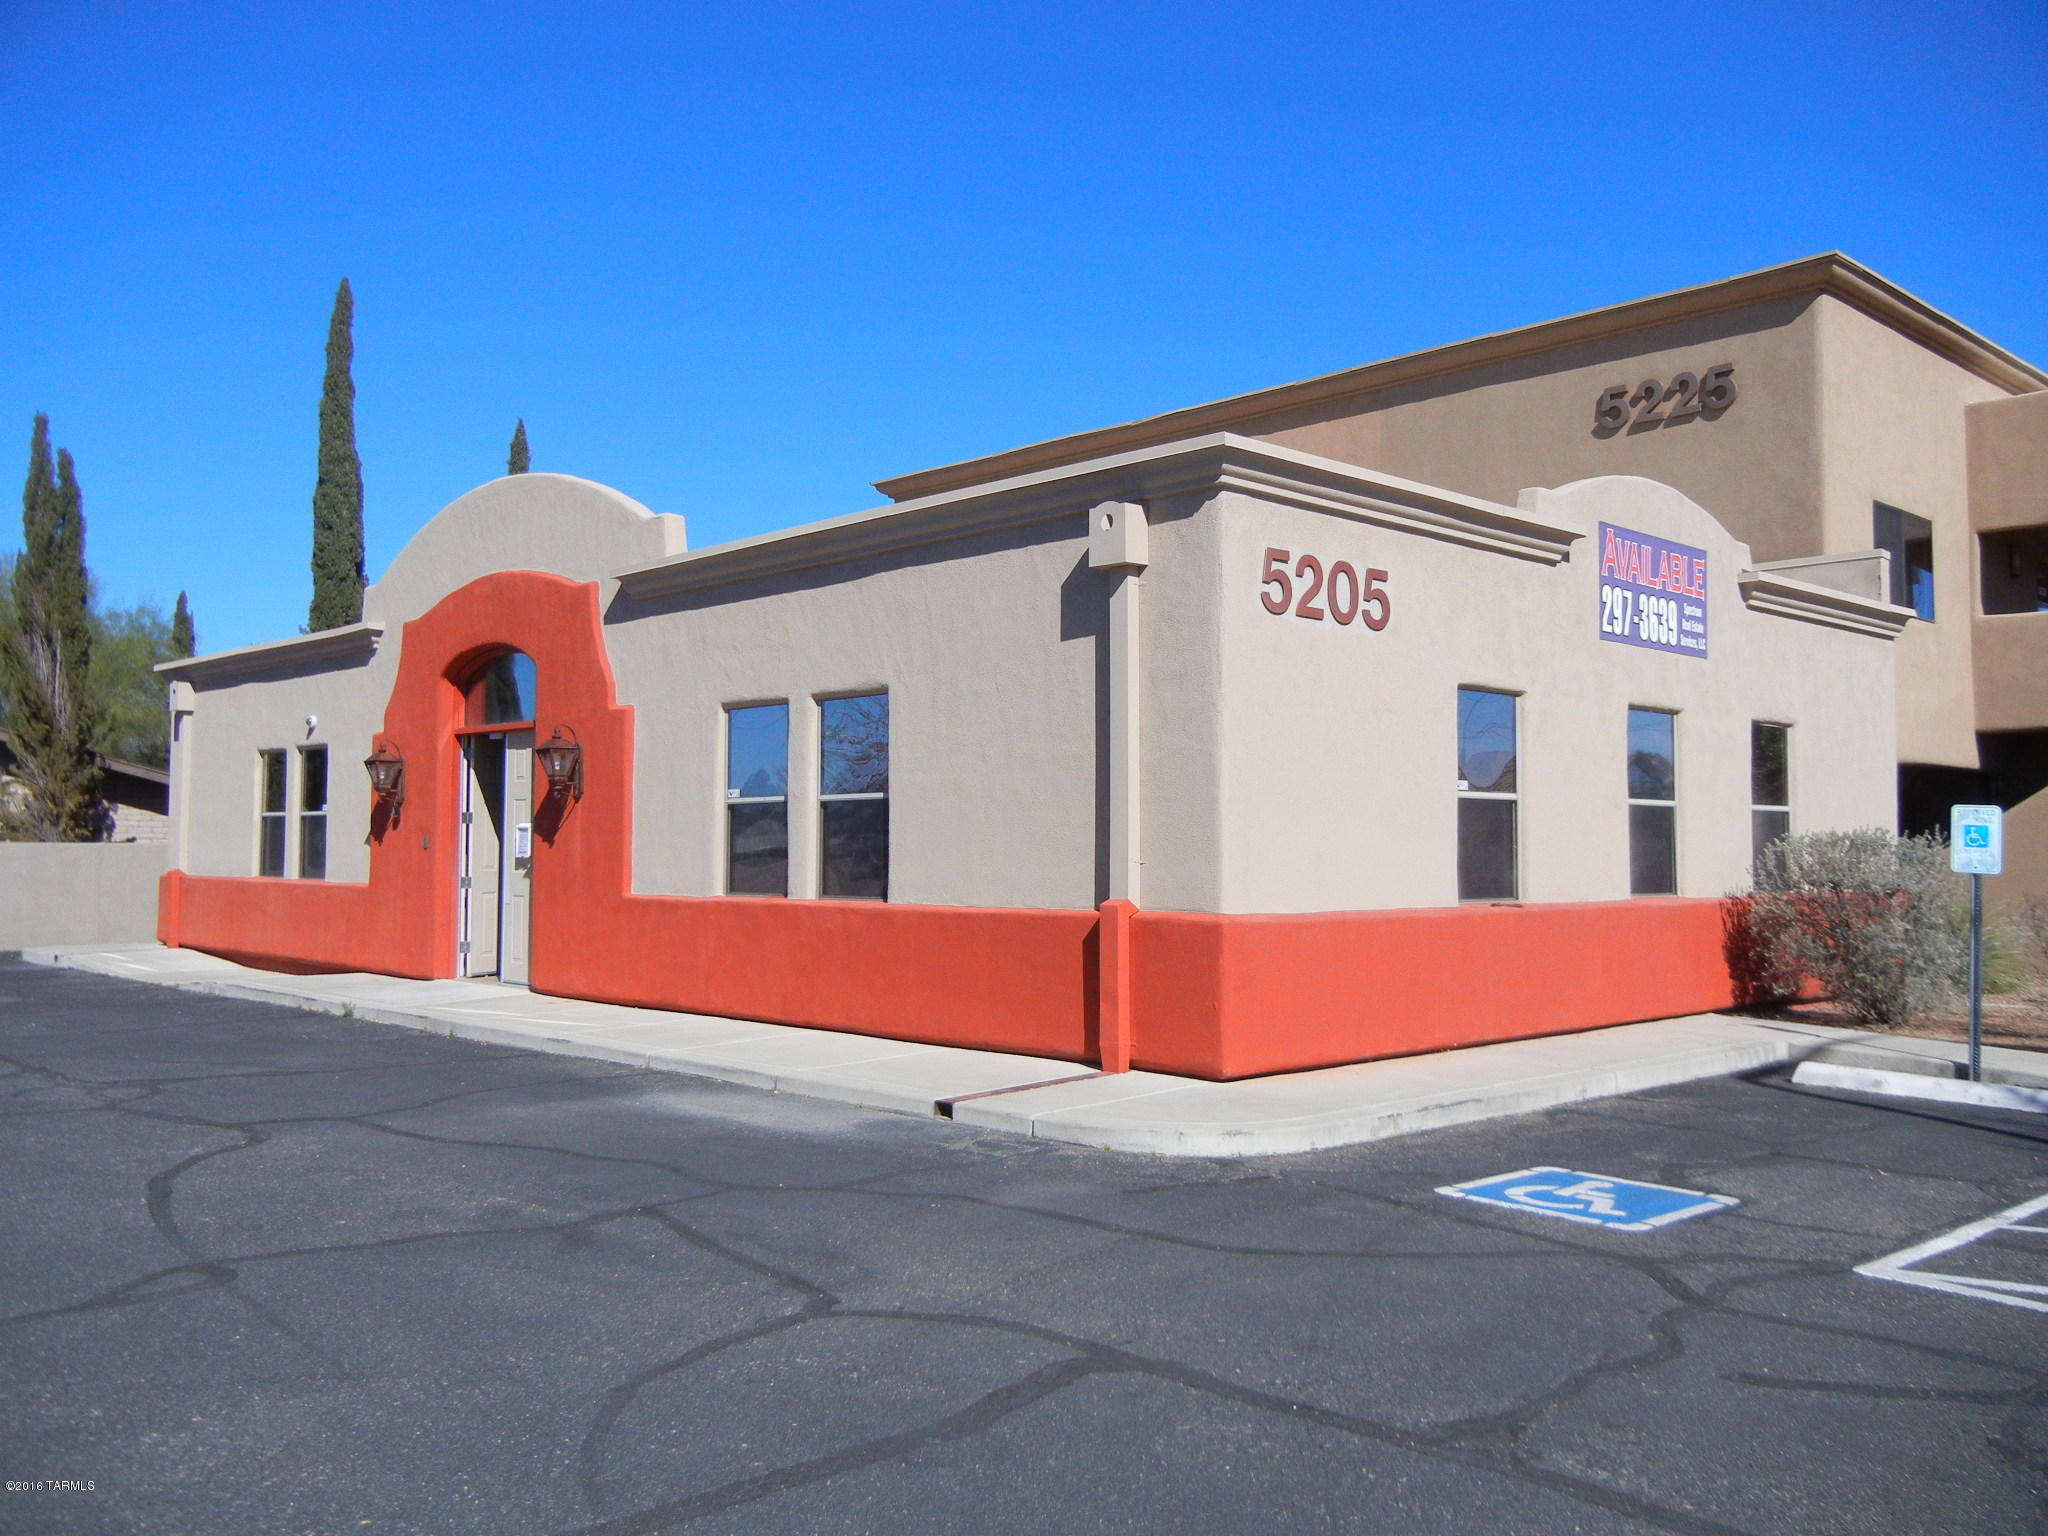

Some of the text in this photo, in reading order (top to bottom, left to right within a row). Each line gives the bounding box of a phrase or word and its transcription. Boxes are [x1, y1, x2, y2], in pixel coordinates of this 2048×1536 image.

[1596, 362, 1737, 430] 5225
[1261, 547, 1391, 631] 5205
[1601, 528, 1705, 600] AVAILABLE
[1601, 584, 1678, 646] 297-3639
